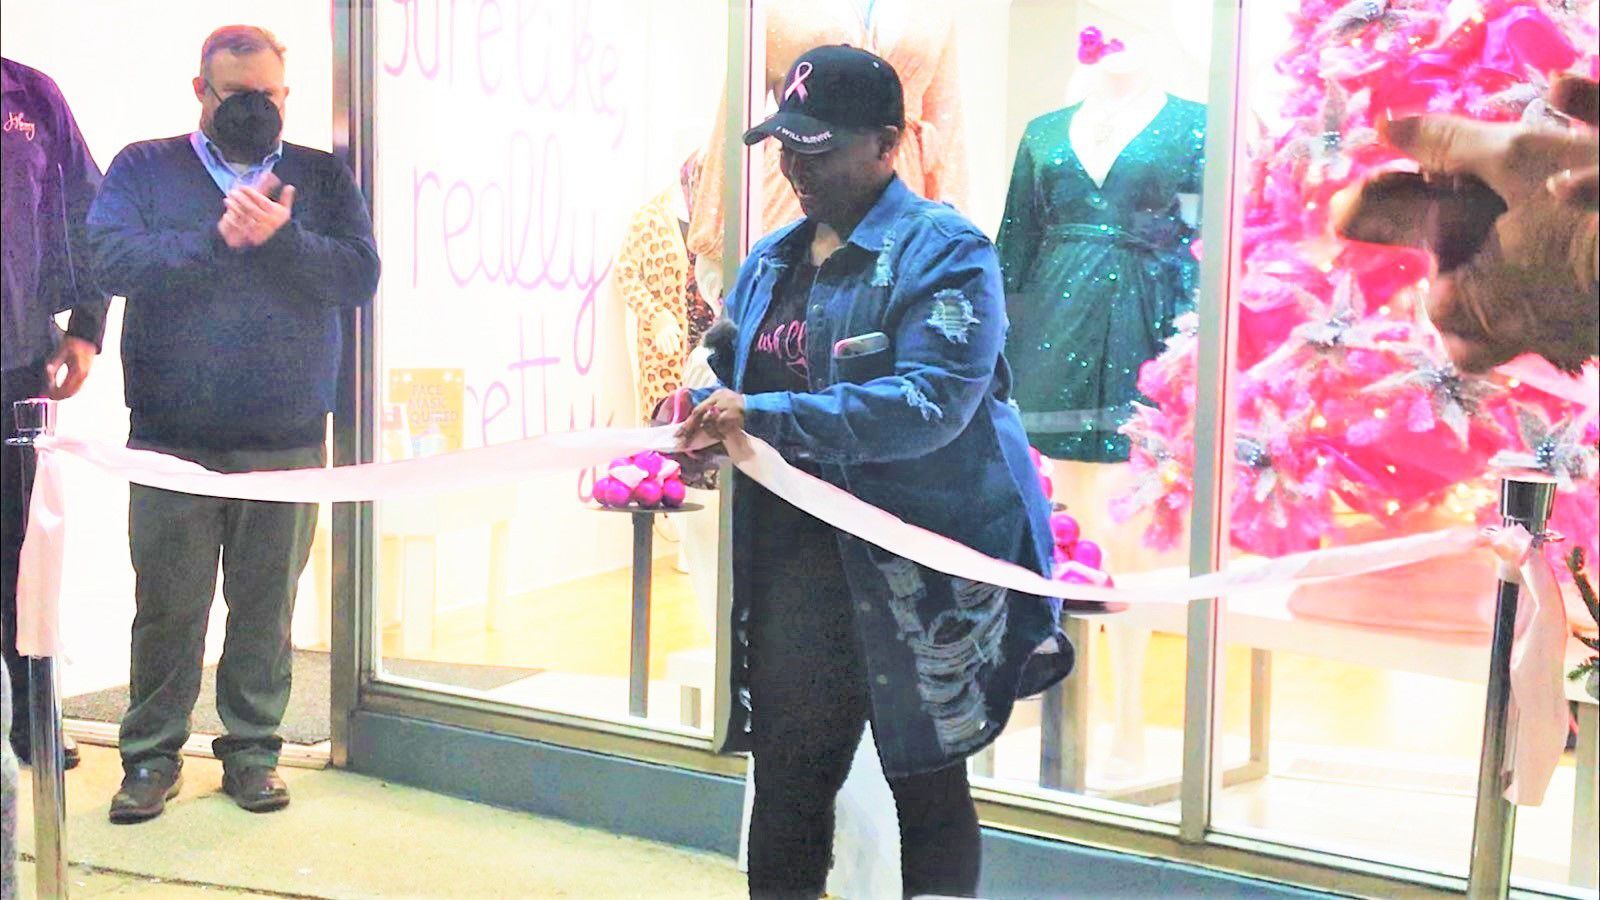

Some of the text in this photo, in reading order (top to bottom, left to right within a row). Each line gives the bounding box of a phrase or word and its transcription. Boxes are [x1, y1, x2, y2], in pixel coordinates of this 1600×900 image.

[782, 127, 802, 142] WILL
[802, 130, 833, 144] SURVIVE
[412, 129, 615, 376] really
[412, 384, 443, 396] FACE
